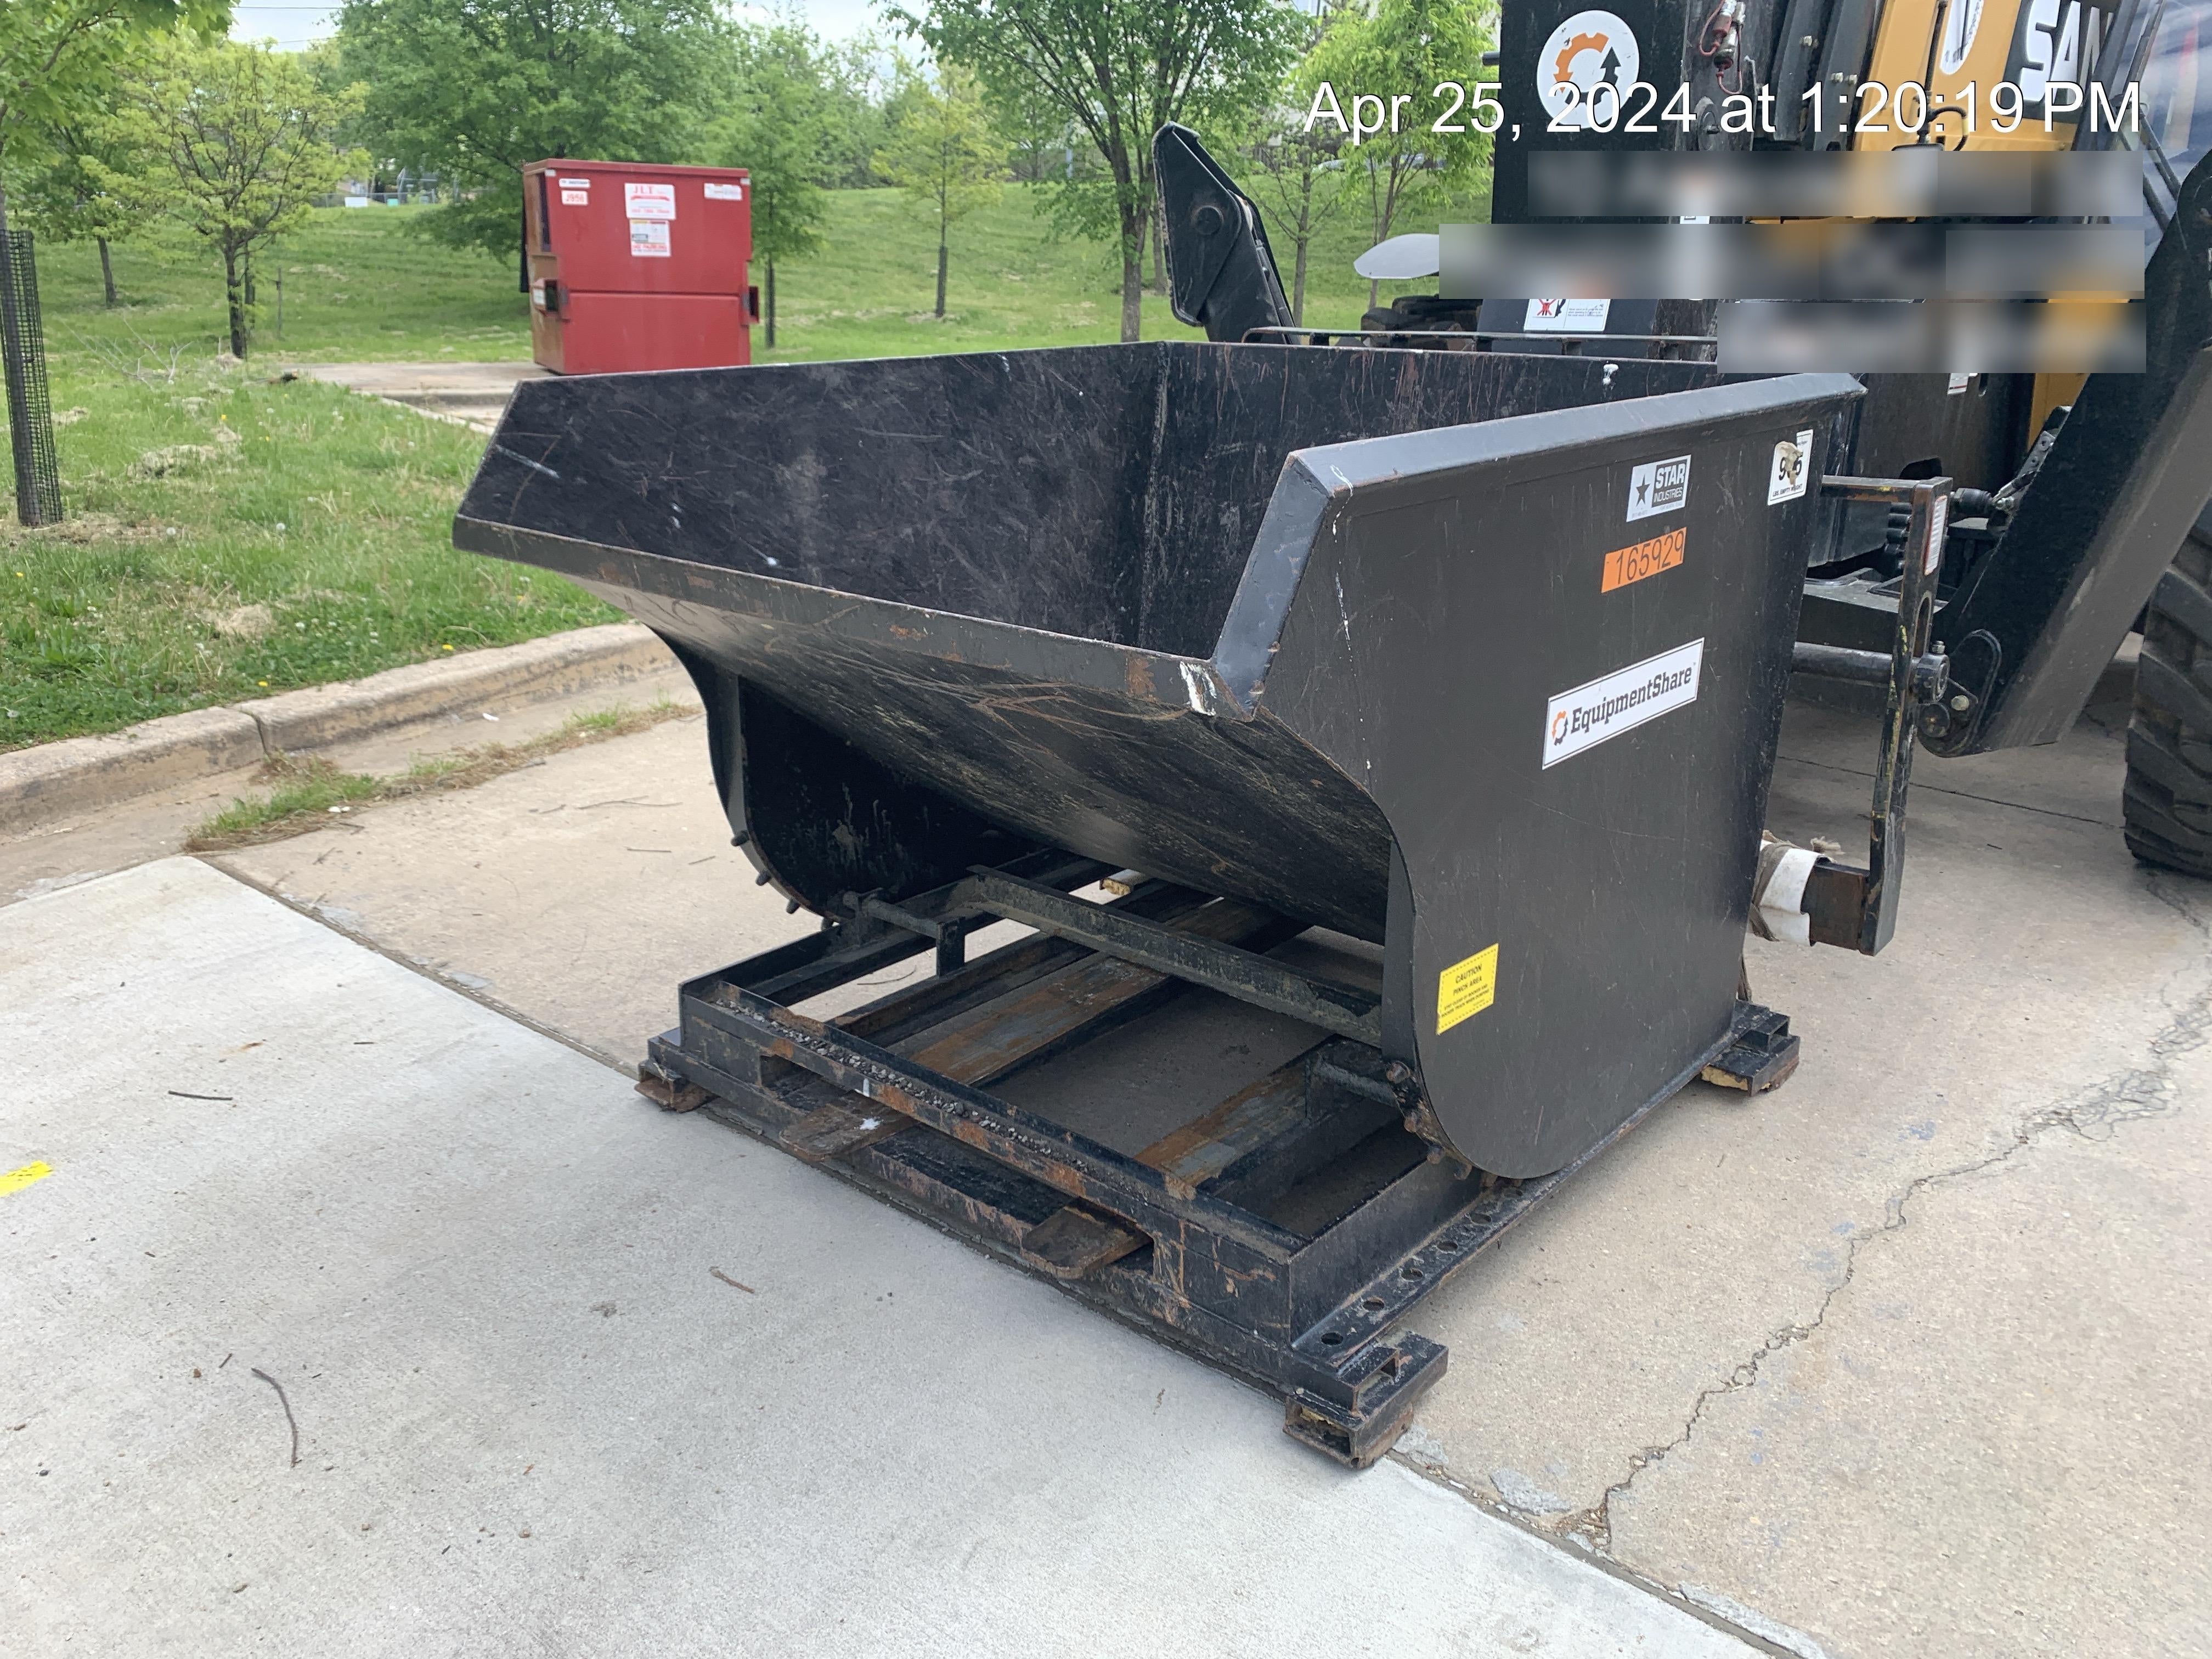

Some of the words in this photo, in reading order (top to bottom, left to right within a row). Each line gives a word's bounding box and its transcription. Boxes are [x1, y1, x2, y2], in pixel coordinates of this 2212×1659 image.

[1656, 463, 1686, 489] STAR
[1654, 486, 1683, 503] INDUSTRIES
[1780, 487, 1791, 495] EMPTY
[1616, 530, 1684, 584] 165929
[1571, 667, 1692, 734] EquipmentShare
[1455, 963, 1482, 984] CAUTION
[1453, 983, 1468, 996] PINCH
[1470, 975, 1482, 986] AREA
